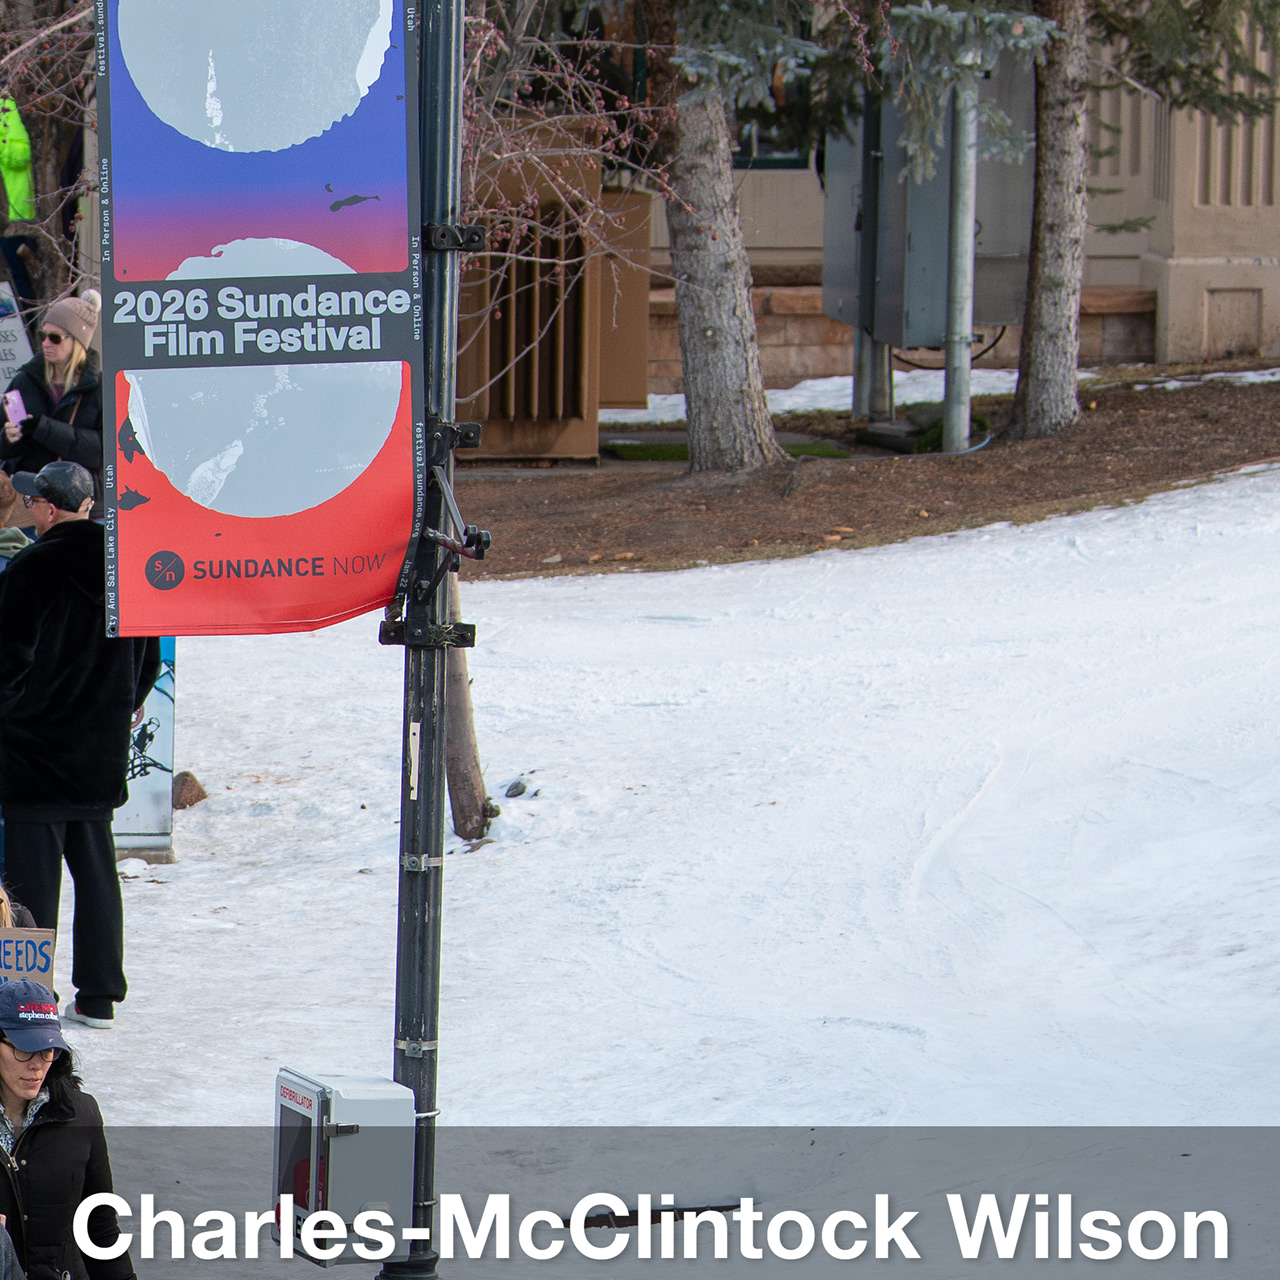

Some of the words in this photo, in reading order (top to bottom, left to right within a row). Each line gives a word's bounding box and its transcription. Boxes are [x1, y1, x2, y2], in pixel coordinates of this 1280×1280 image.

[406, 8, 414, 31] Utah
[100, 158, 109, 194] Online
[102, 210, 110, 246] Person
[412, 236, 420, 249] In
[102, 250, 110, 262] In
[412, 252, 420, 289] Person
[113, 287, 209, 324] 2026
[217, 284, 411, 320] Sundance
[144, 323, 224, 357] Film
[234, 317, 381, 354] Festival
[106, 464, 114, 488] Utah
[412, 422, 424, 538] festival.sundance.org
[106, 507, 116, 530] City
[107, 536, 115, 558] Lake
[108, 564, 116, 586] Salt
[193, 557, 325, 579] SUNDANCE
[333, 552, 387, 575] NOW
[108, 592, 116, 610] And
[280, 1085, 313, 1111] DEFIBRILLATOR
